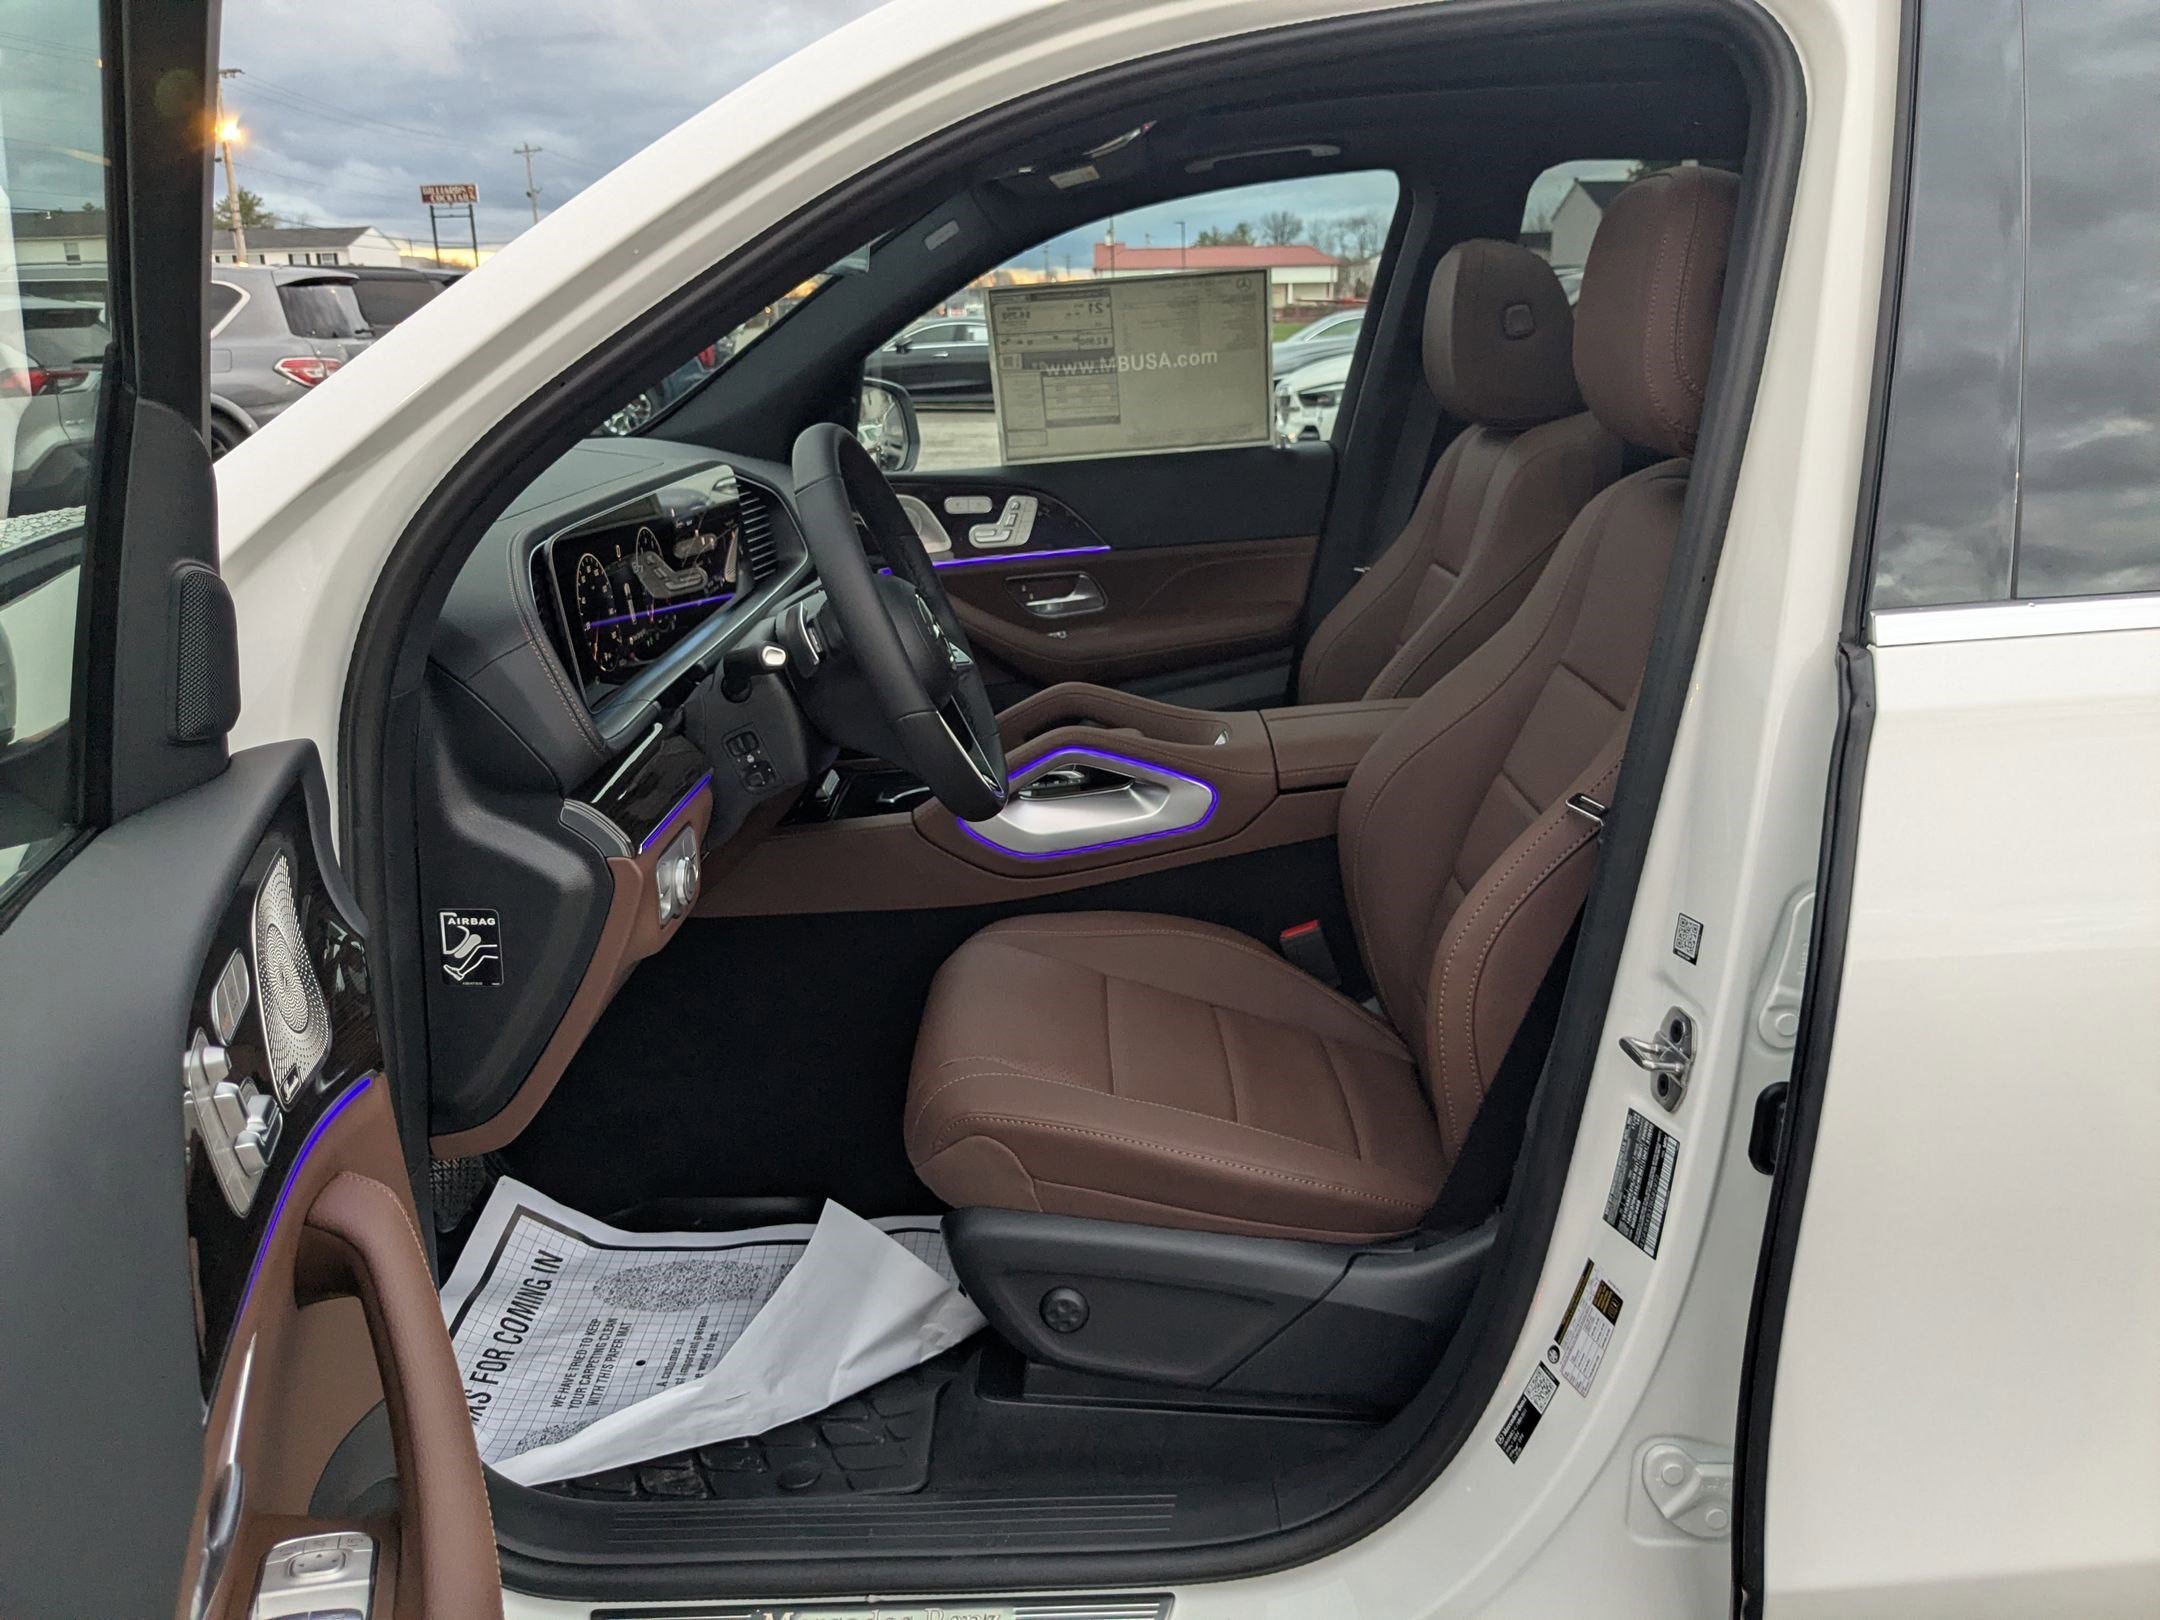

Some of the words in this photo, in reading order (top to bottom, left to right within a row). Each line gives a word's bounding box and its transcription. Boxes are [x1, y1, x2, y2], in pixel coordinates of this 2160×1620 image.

[1046, 351, 1218, 375] www.MBUSA.com
[447, 917, 496, 926] AIRBAG
[469, 1347, 516, 1385] FOR
[493, 1278, 553, 1345] COMING
[531, 1249, 564, 1274] IN
[616, 1322, 632, 1338] MAT
[579, 1337, 594, 1348] TO
[605, 1340, 625, 1362] PAPER
[567, 1387, 588, 1410] YOUR
[579, 1342, 608, 1386] CARPETING
[599, 1317, 618, 1341] CLEAN
[568, 1349, 588, 1371] TRIED
[661, 1347, 682, 1380] customer
[676, 1341, 700, 1376] important
[557, 1372, 577, 1394] HAVE
[596, 1364, 615, 1384] THIS
[550, 1394, 567, 1408] WE
[586, 1385, 607, 1407] WITH
